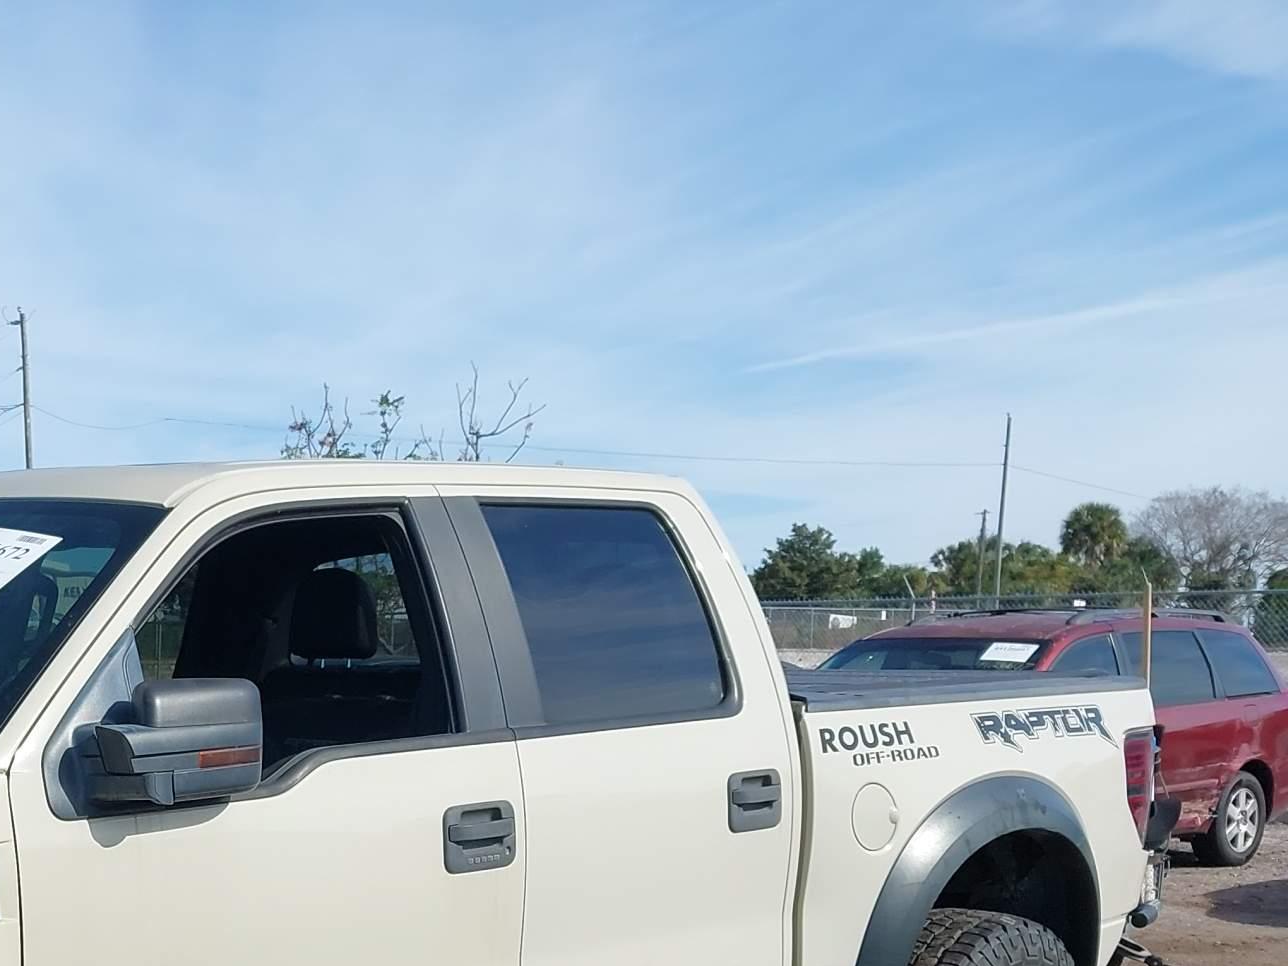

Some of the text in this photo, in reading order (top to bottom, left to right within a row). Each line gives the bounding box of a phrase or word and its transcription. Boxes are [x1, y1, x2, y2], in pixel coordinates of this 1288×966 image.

[819, 721, 915, 753] ROUSH
[970, 704, 1119, 752] RAPTOR
[853, 745, 940, 767] OFF-ROAD
